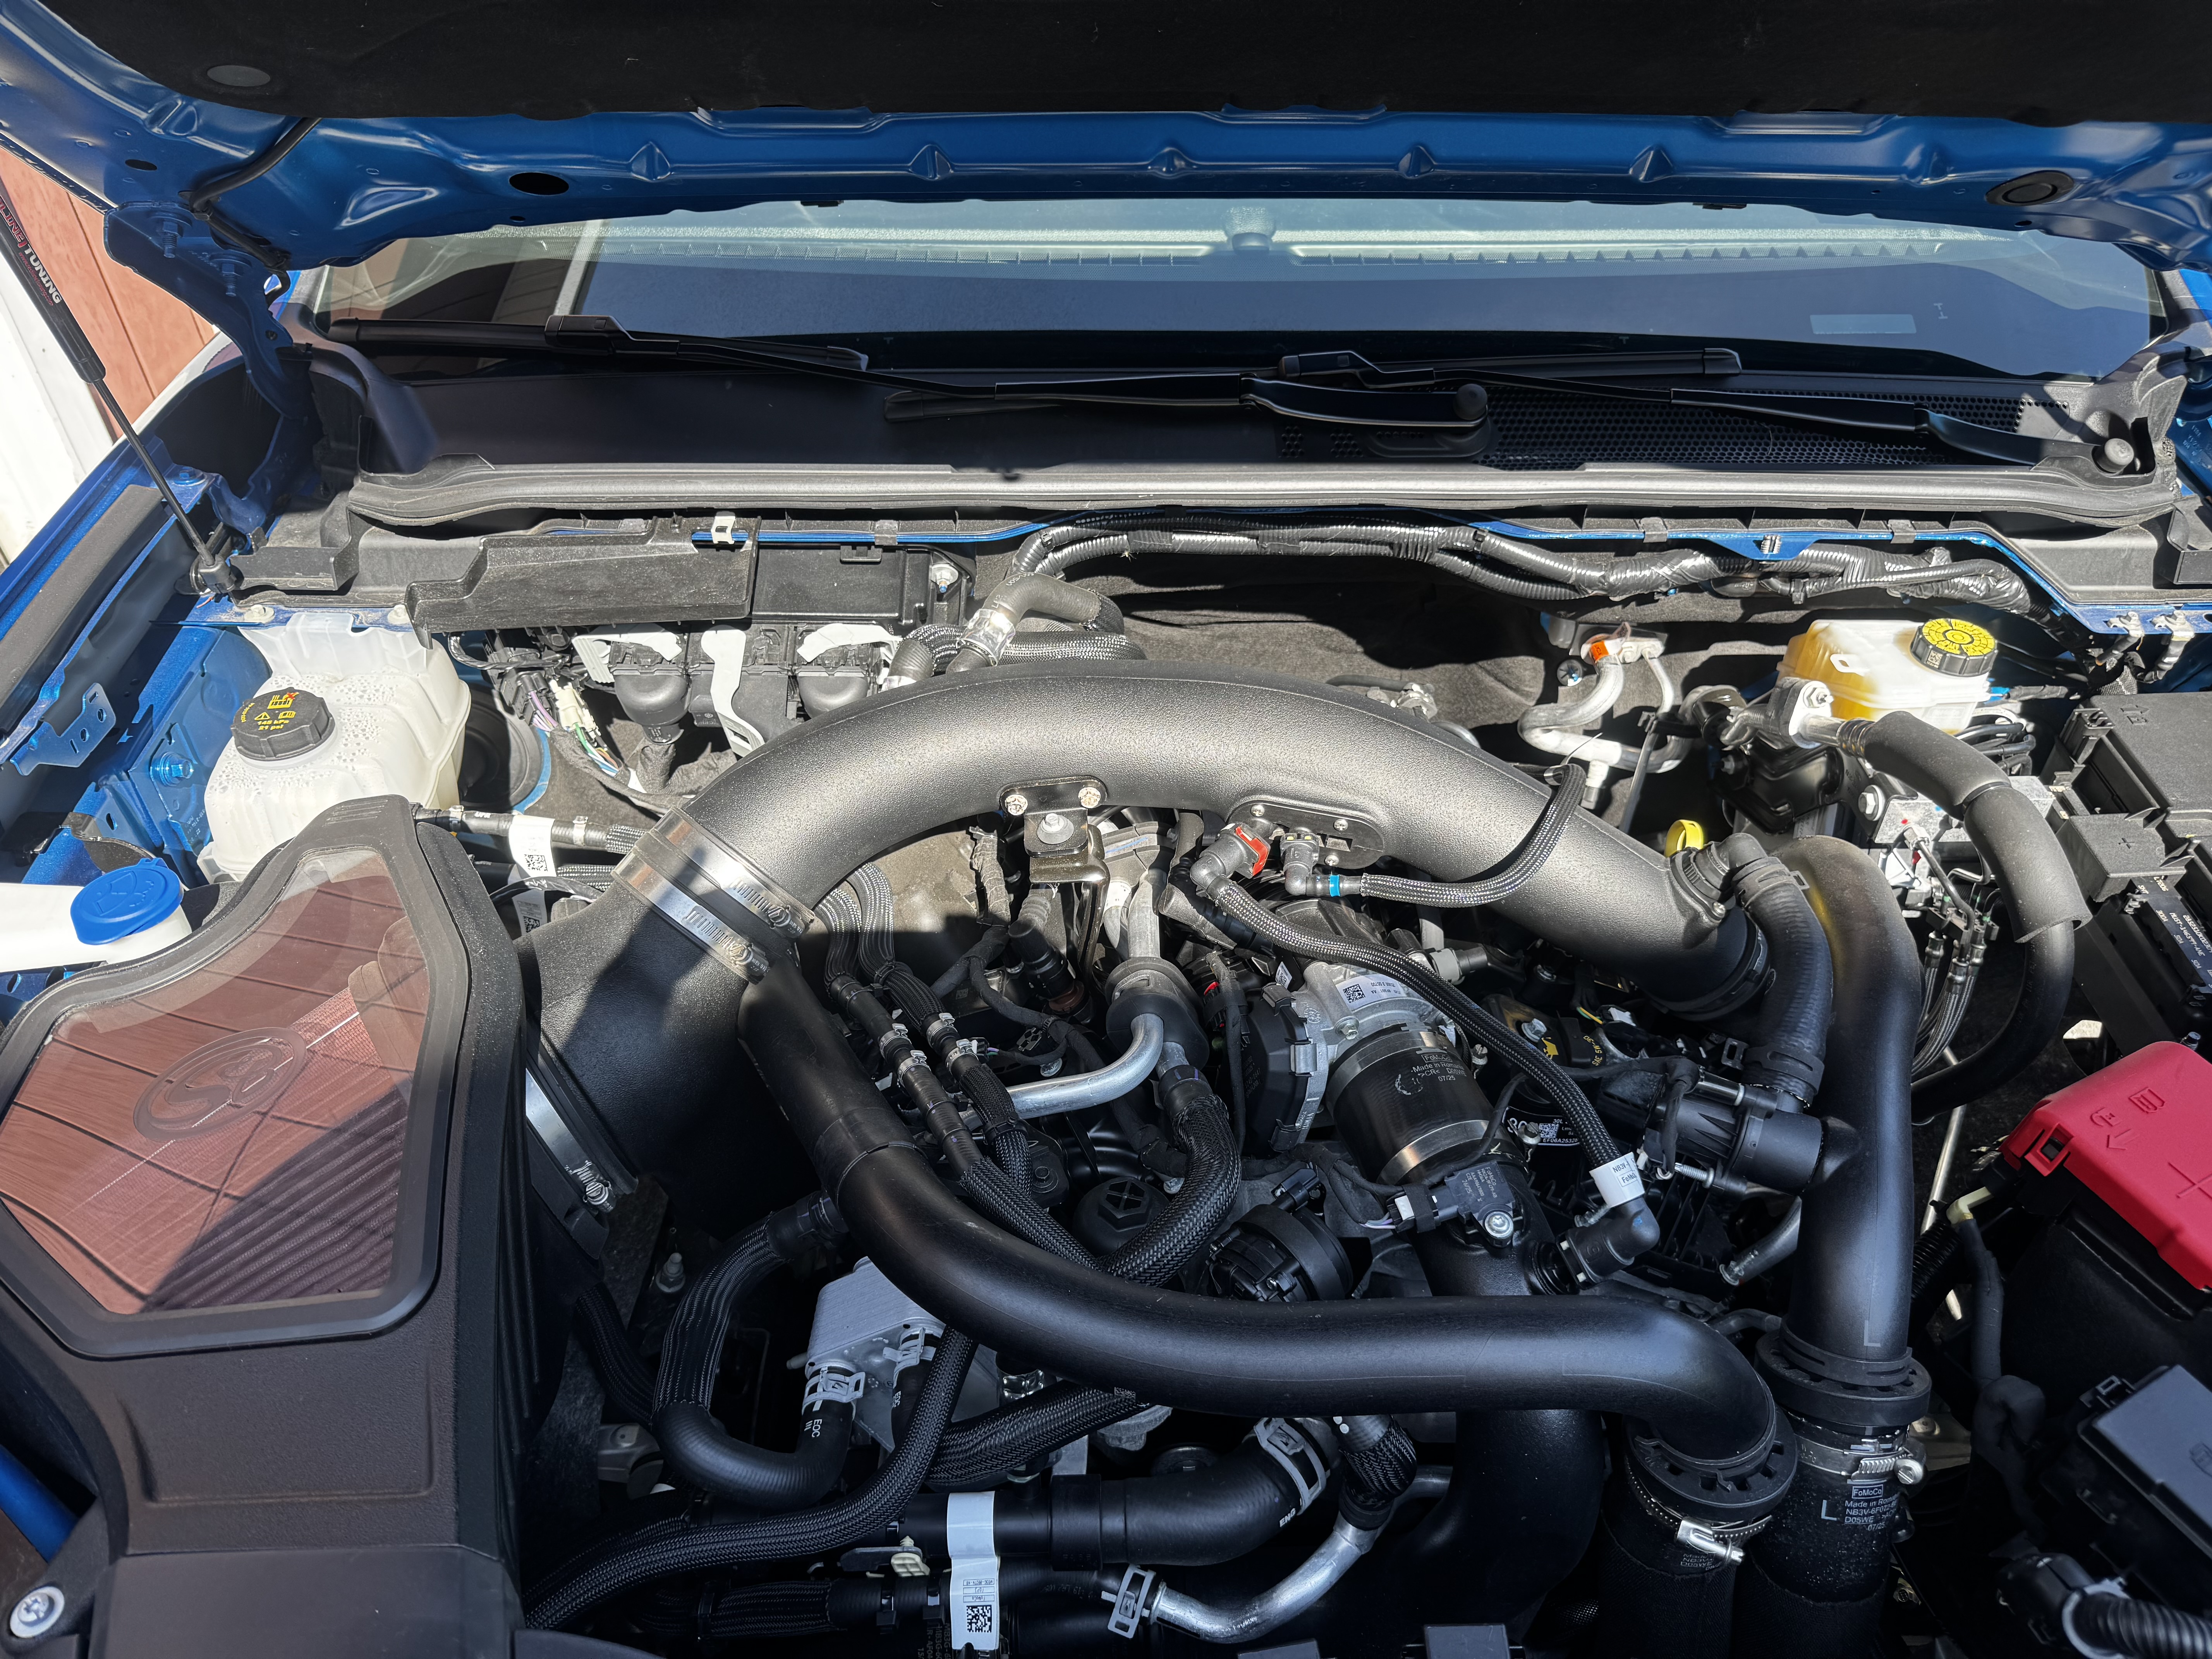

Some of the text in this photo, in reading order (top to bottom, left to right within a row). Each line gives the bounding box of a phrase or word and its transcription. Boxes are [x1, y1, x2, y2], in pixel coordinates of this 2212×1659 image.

[24, 243, 62, 304] TUNING
[2174, 934, 2185, 944] 50A
[2191, 959, 2202, 969] 50A
[1583, 1036, 1602, 1066] SAE 5W-30
[1413, 1064, 1433, 1072] Made
[1486, 1166, 1496, 1186] FoMoCo
[1462, 1179, 1473, 1194] 26/25
[812, 1419, 823, 1438] EOC
[1853, 1488, 1882, 1496] FoMoCo
[1279, 1508, 1296, 1527] ENG
[1867, 1522, 1886, 1531] 07/25
